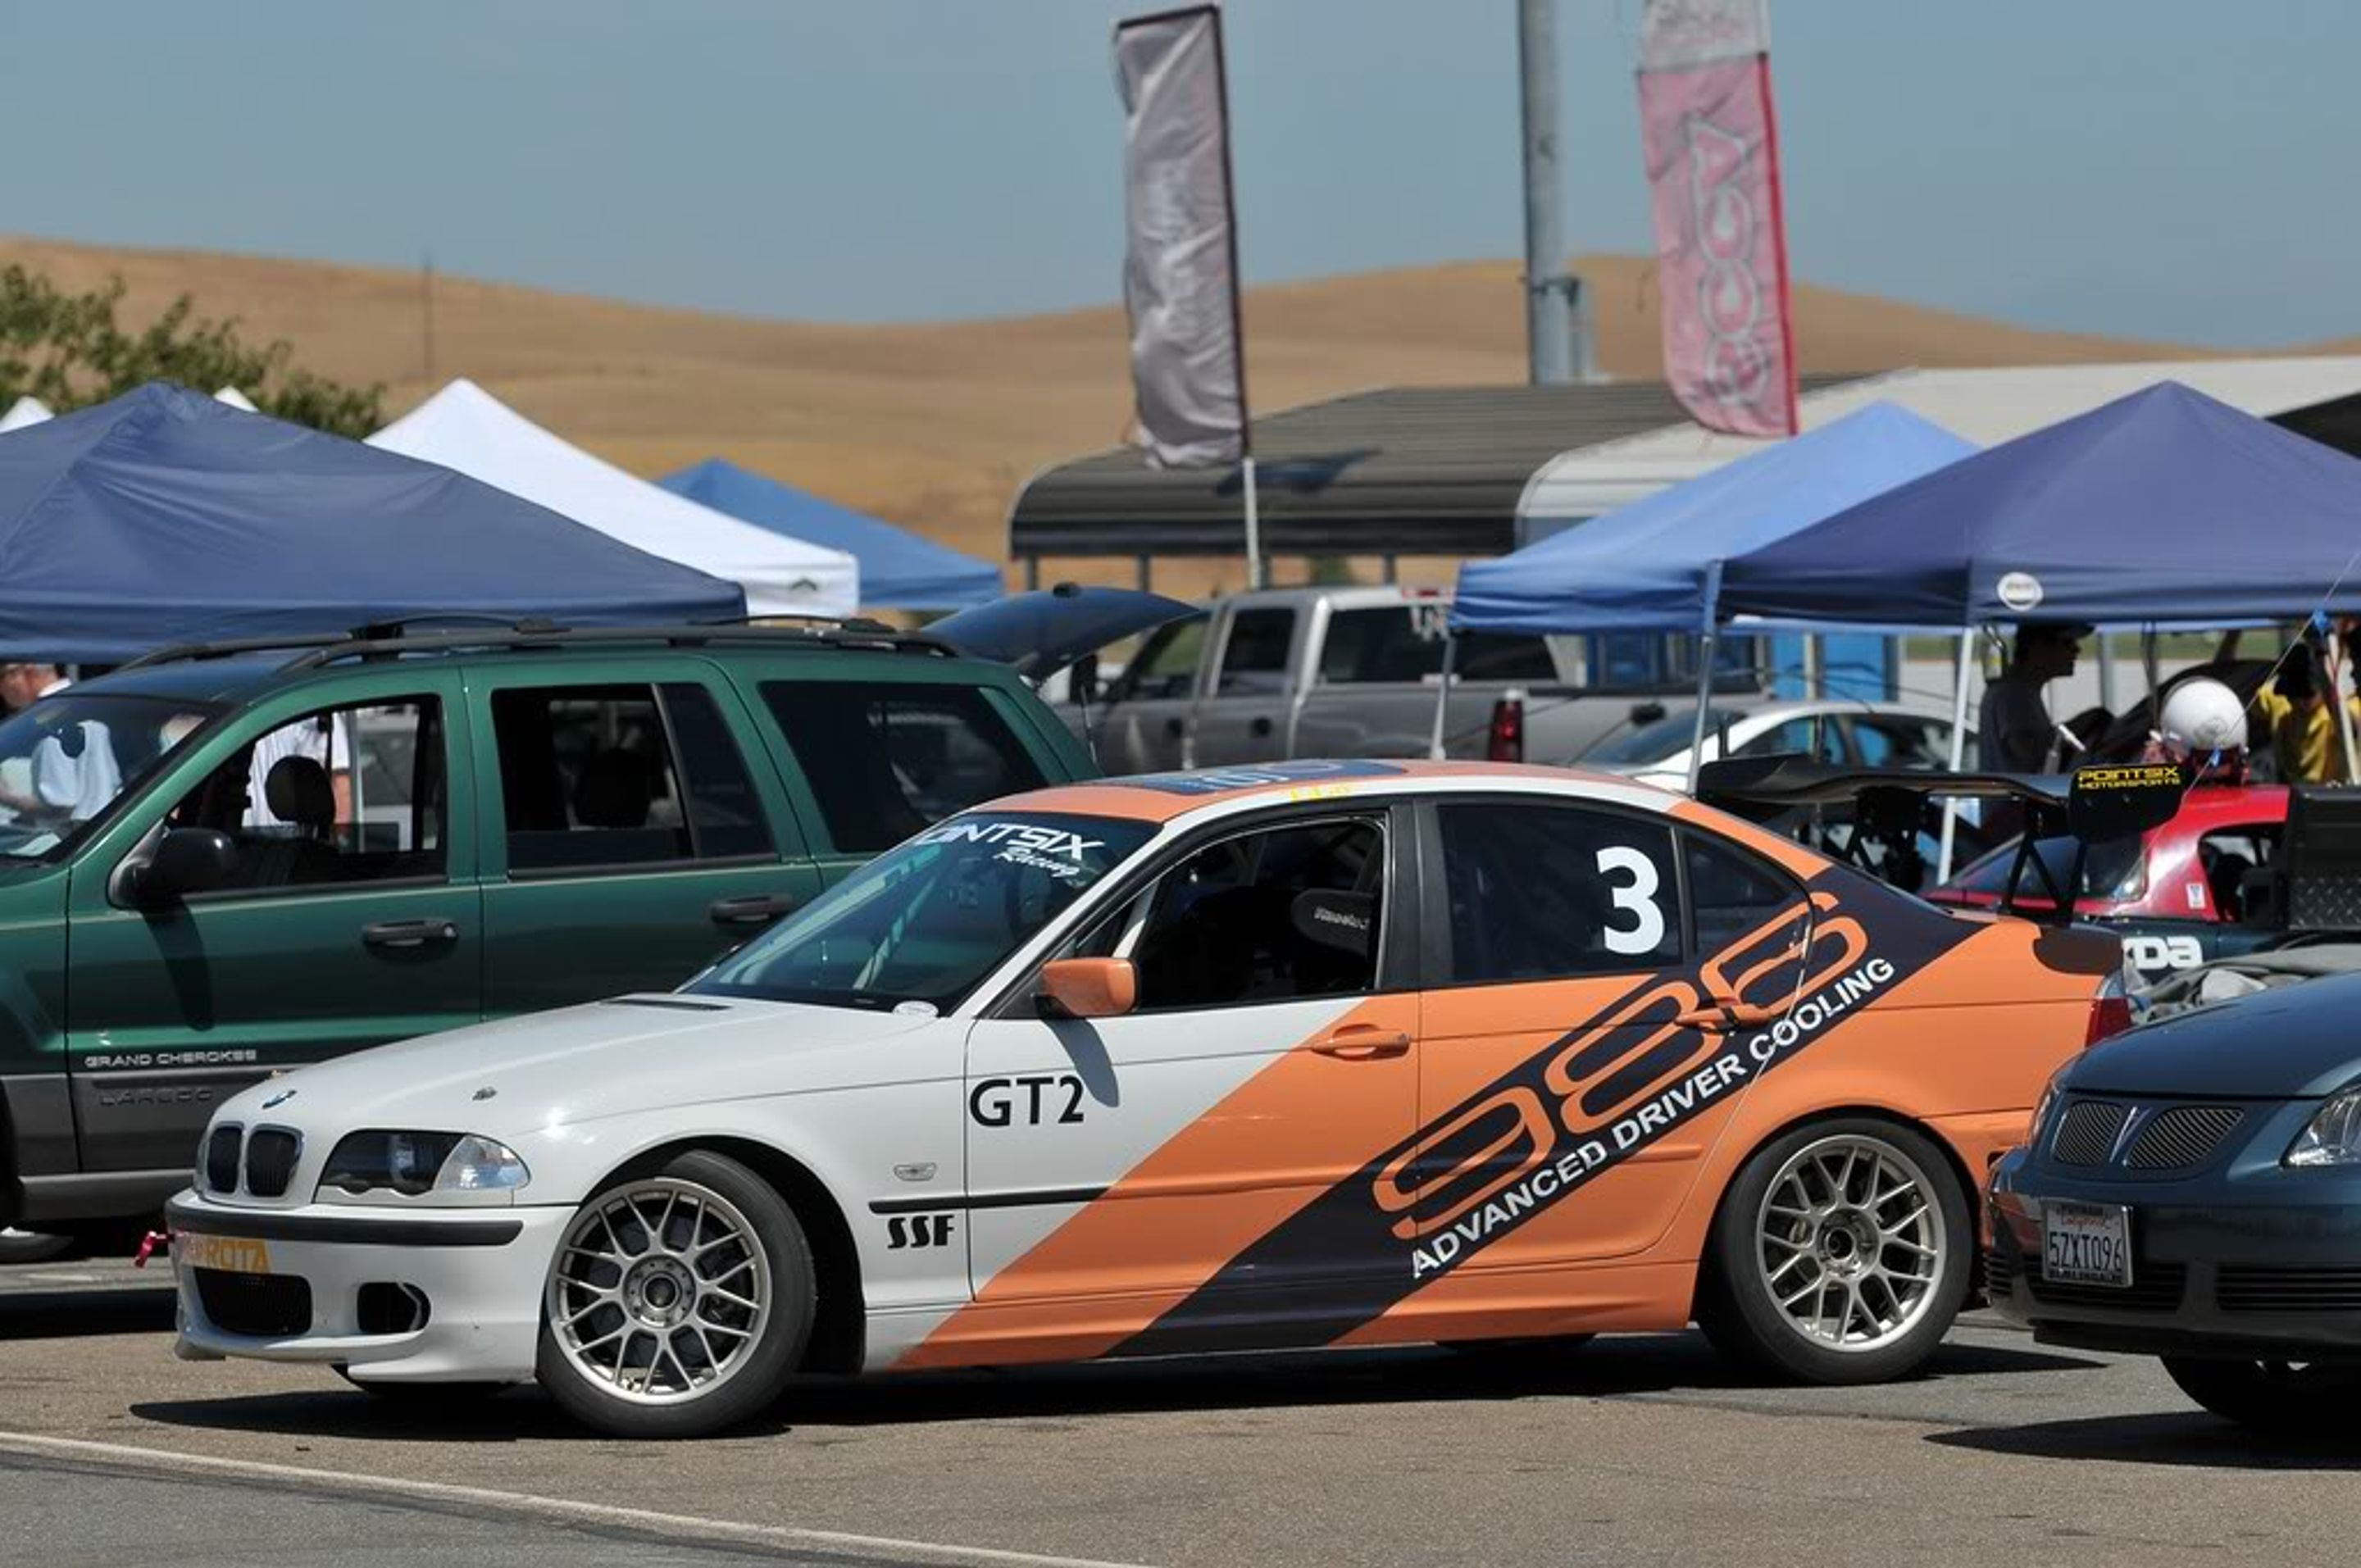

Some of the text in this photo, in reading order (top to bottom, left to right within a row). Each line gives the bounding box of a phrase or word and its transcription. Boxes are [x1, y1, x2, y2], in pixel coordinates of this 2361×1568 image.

[1596, 846, 1665, 954] 3
[85, 1050, 257, 1066] GRAND CHEROKEE
[969, 1075, 1085, 1127] GT2
[1408, 957, 1896, 1279] ADVANCED DRIVER COOLING
[887, 1214, 955, 1249] SSF
[2049, 1231, 2123, 1272] 5ZXT096
